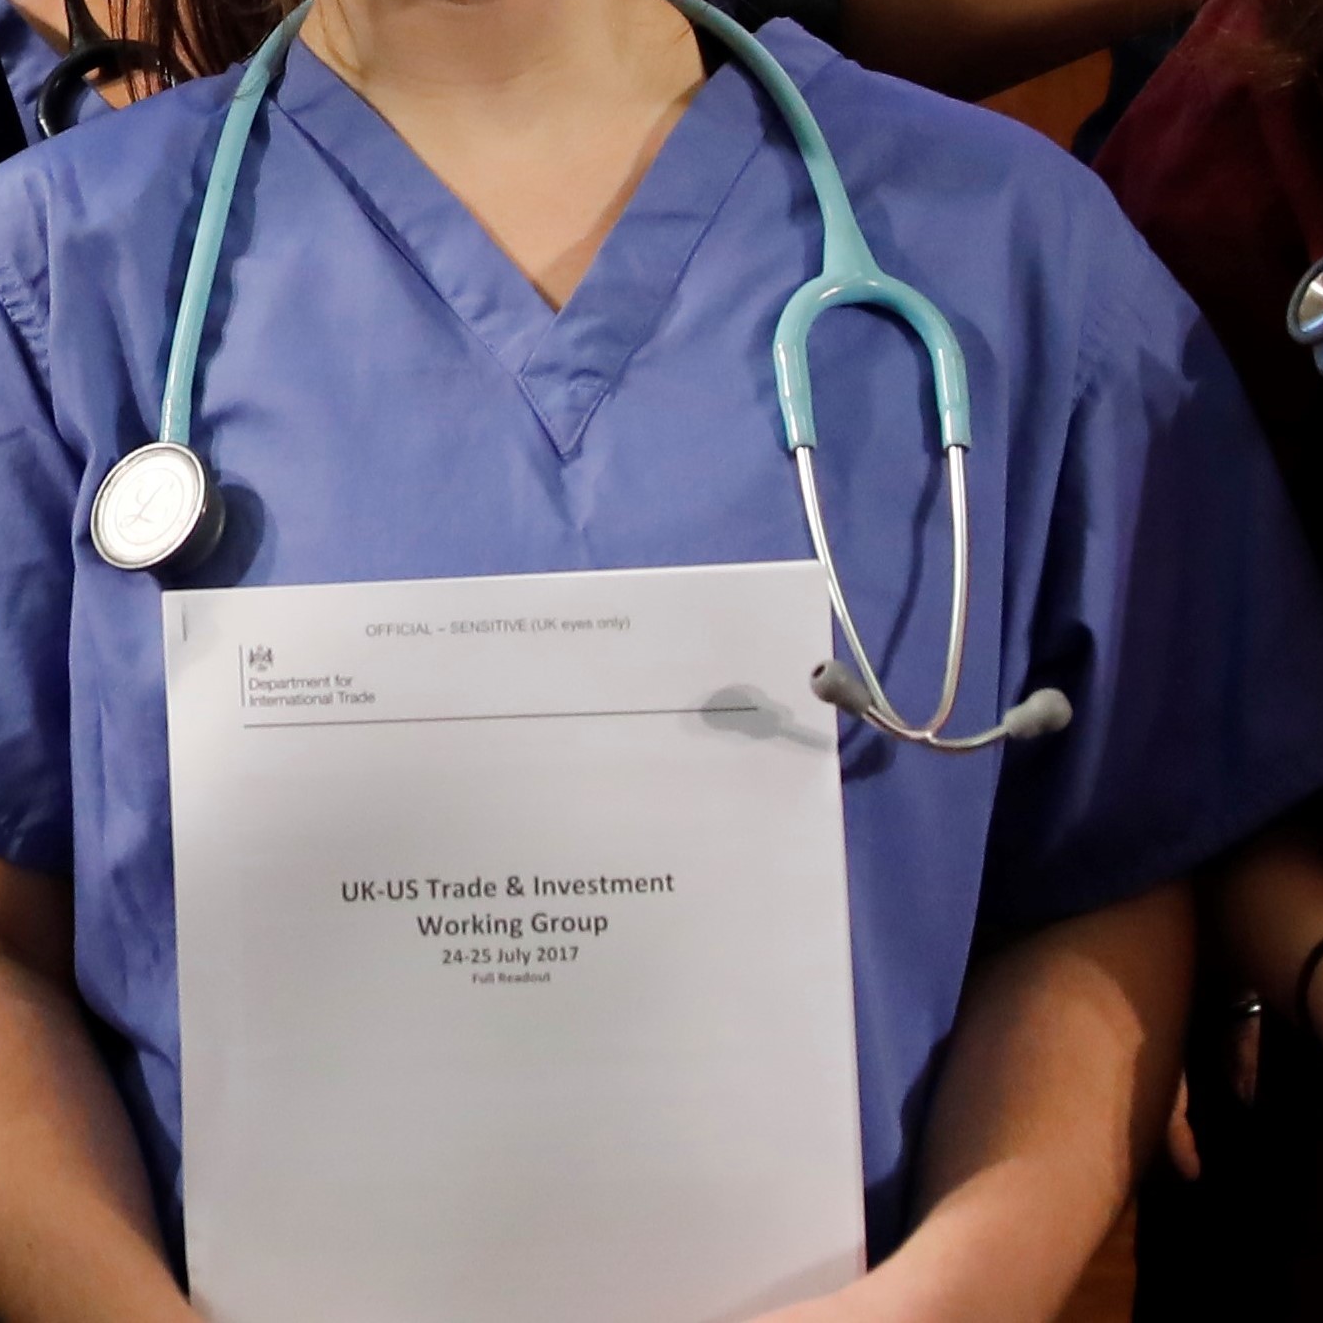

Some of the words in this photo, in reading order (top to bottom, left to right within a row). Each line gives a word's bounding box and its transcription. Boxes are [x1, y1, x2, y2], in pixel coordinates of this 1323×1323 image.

[365, 623, 432, 637] OFFICIAL
[450, 618, 527, 634] SENSITIVE
[531, 618, 557, 633] (UK
[561, 619, 594, 632] eyes
[597, 616, 630, 631] only)
[248, 676, 330, 693] Department
[334, 674, 353, 687] for
[249, 691, 333, 707] International
[337, 691, 376, 704] Trade
[342, 879, 418, 902] UK-US
[426, 876, 497, 899] Trade
[506, 876, 525, 896] &
[534, 874, 674, 896] Investment
[417, 914, 523, 939] Working
[531, 912, 608, 936] Group
[443, 948, 491, 964] 24-25
[498, 947, 531, 966] July
[537, 946, 579, 962] 2017
[472, 972, 495, 984] Full
[498, 972, 551, 983] Readout
